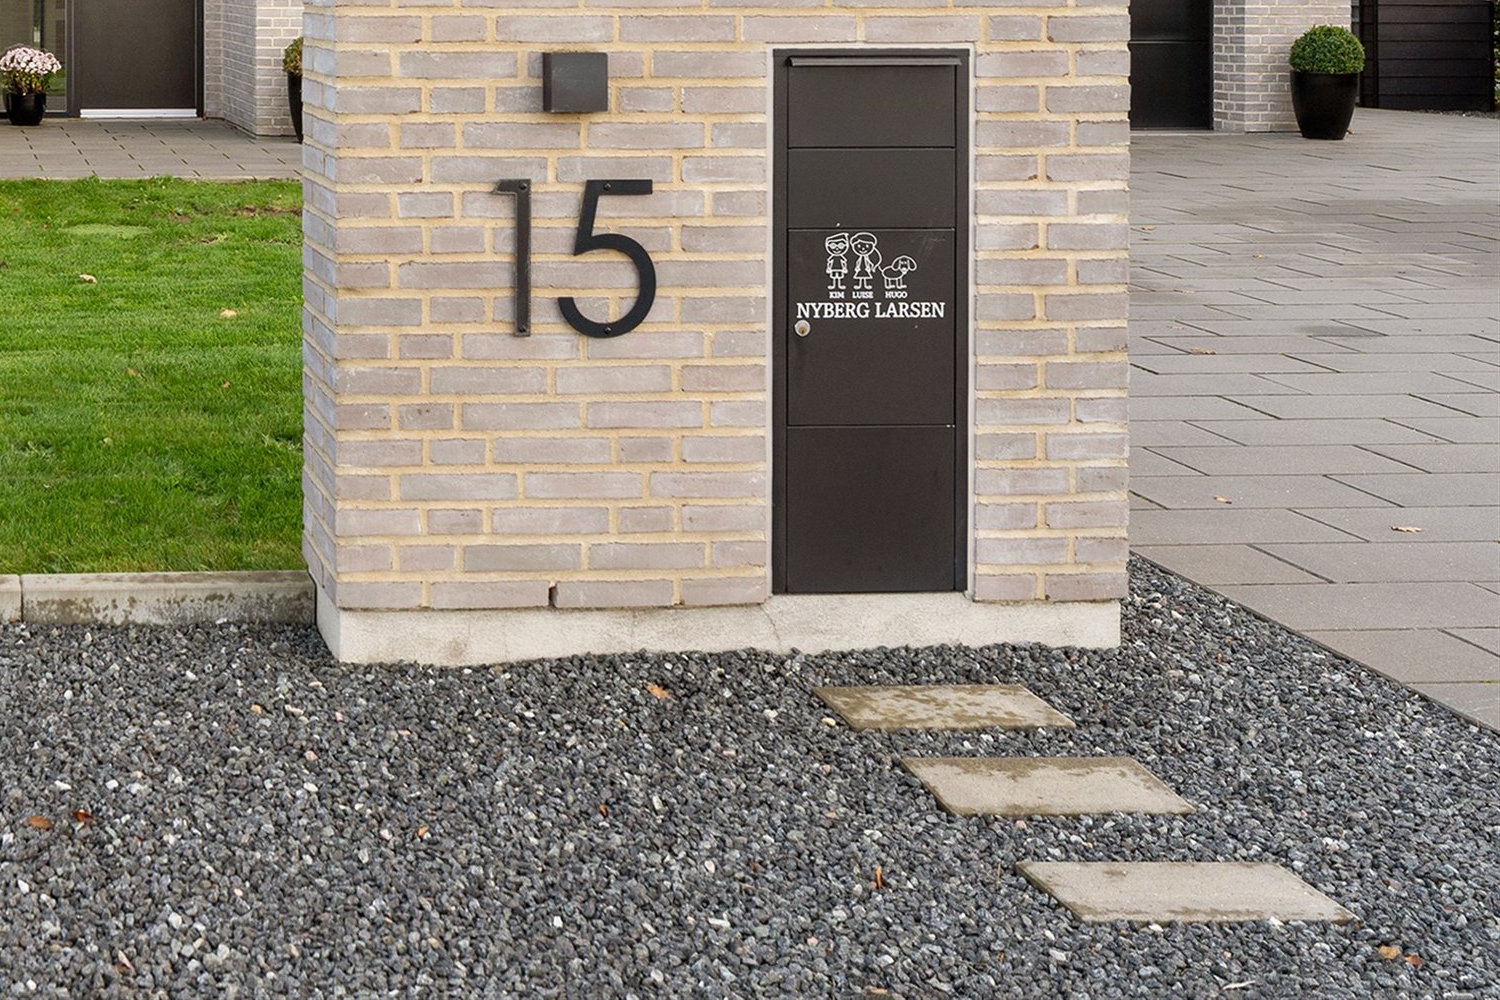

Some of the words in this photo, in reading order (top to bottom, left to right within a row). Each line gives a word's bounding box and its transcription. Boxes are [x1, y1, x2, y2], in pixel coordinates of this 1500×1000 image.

[492, 178, 657, 339] 15
[829, 290, 845, 298] KIM
[852, 290, 873, 298] LUISE
[885, 290, 908, 298] HUGO
[796, 302, 870, 318] NYBERG
[875, 301, 945, 318] LARSEN
